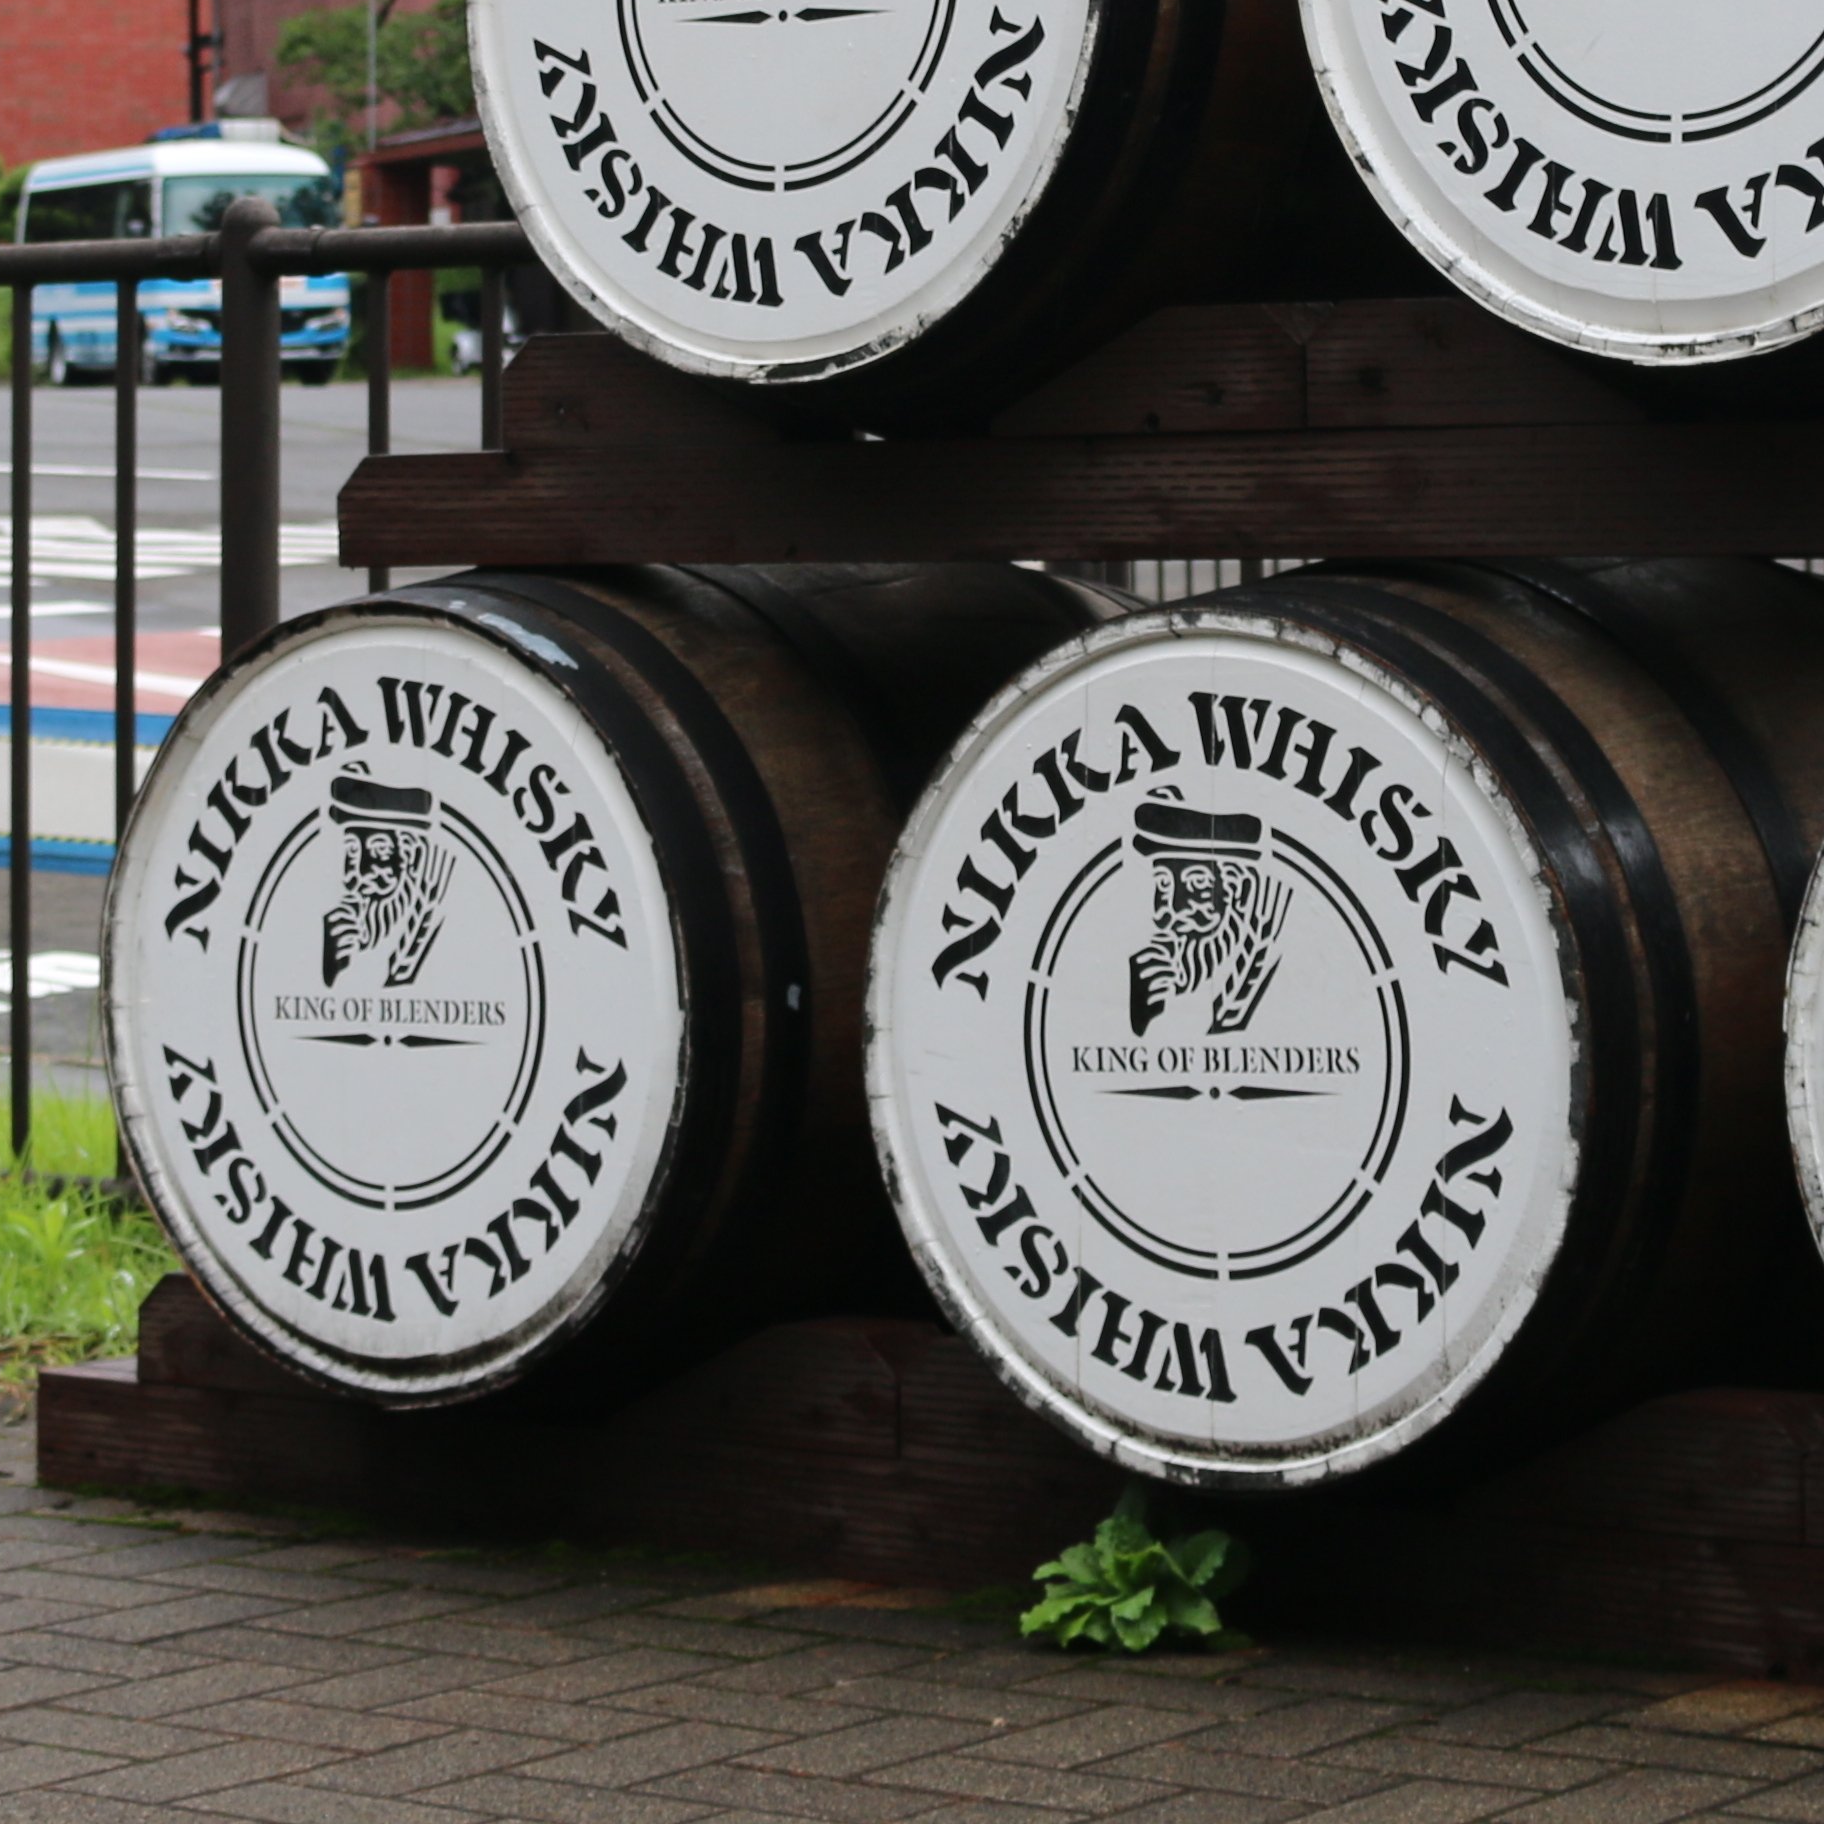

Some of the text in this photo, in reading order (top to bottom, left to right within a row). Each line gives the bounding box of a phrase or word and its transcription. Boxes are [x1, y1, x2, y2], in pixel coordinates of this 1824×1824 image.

[534, 5, 1044, 307] NIKKA WHISKY
[165, 677, 628, 953] NIKKA WHISKY
[932, 692, 1509, 1002] NIKKA WHISKY
[274, 996, 505, 1026] KING OF BLENDERS
[1072, 1047, 1360, 1075] KING OF BLENDERS
[164, 1045, 628, 1322] NIKKA WHISKY
[935, 1094, 1513, 1404] NIKKA WHISKY
